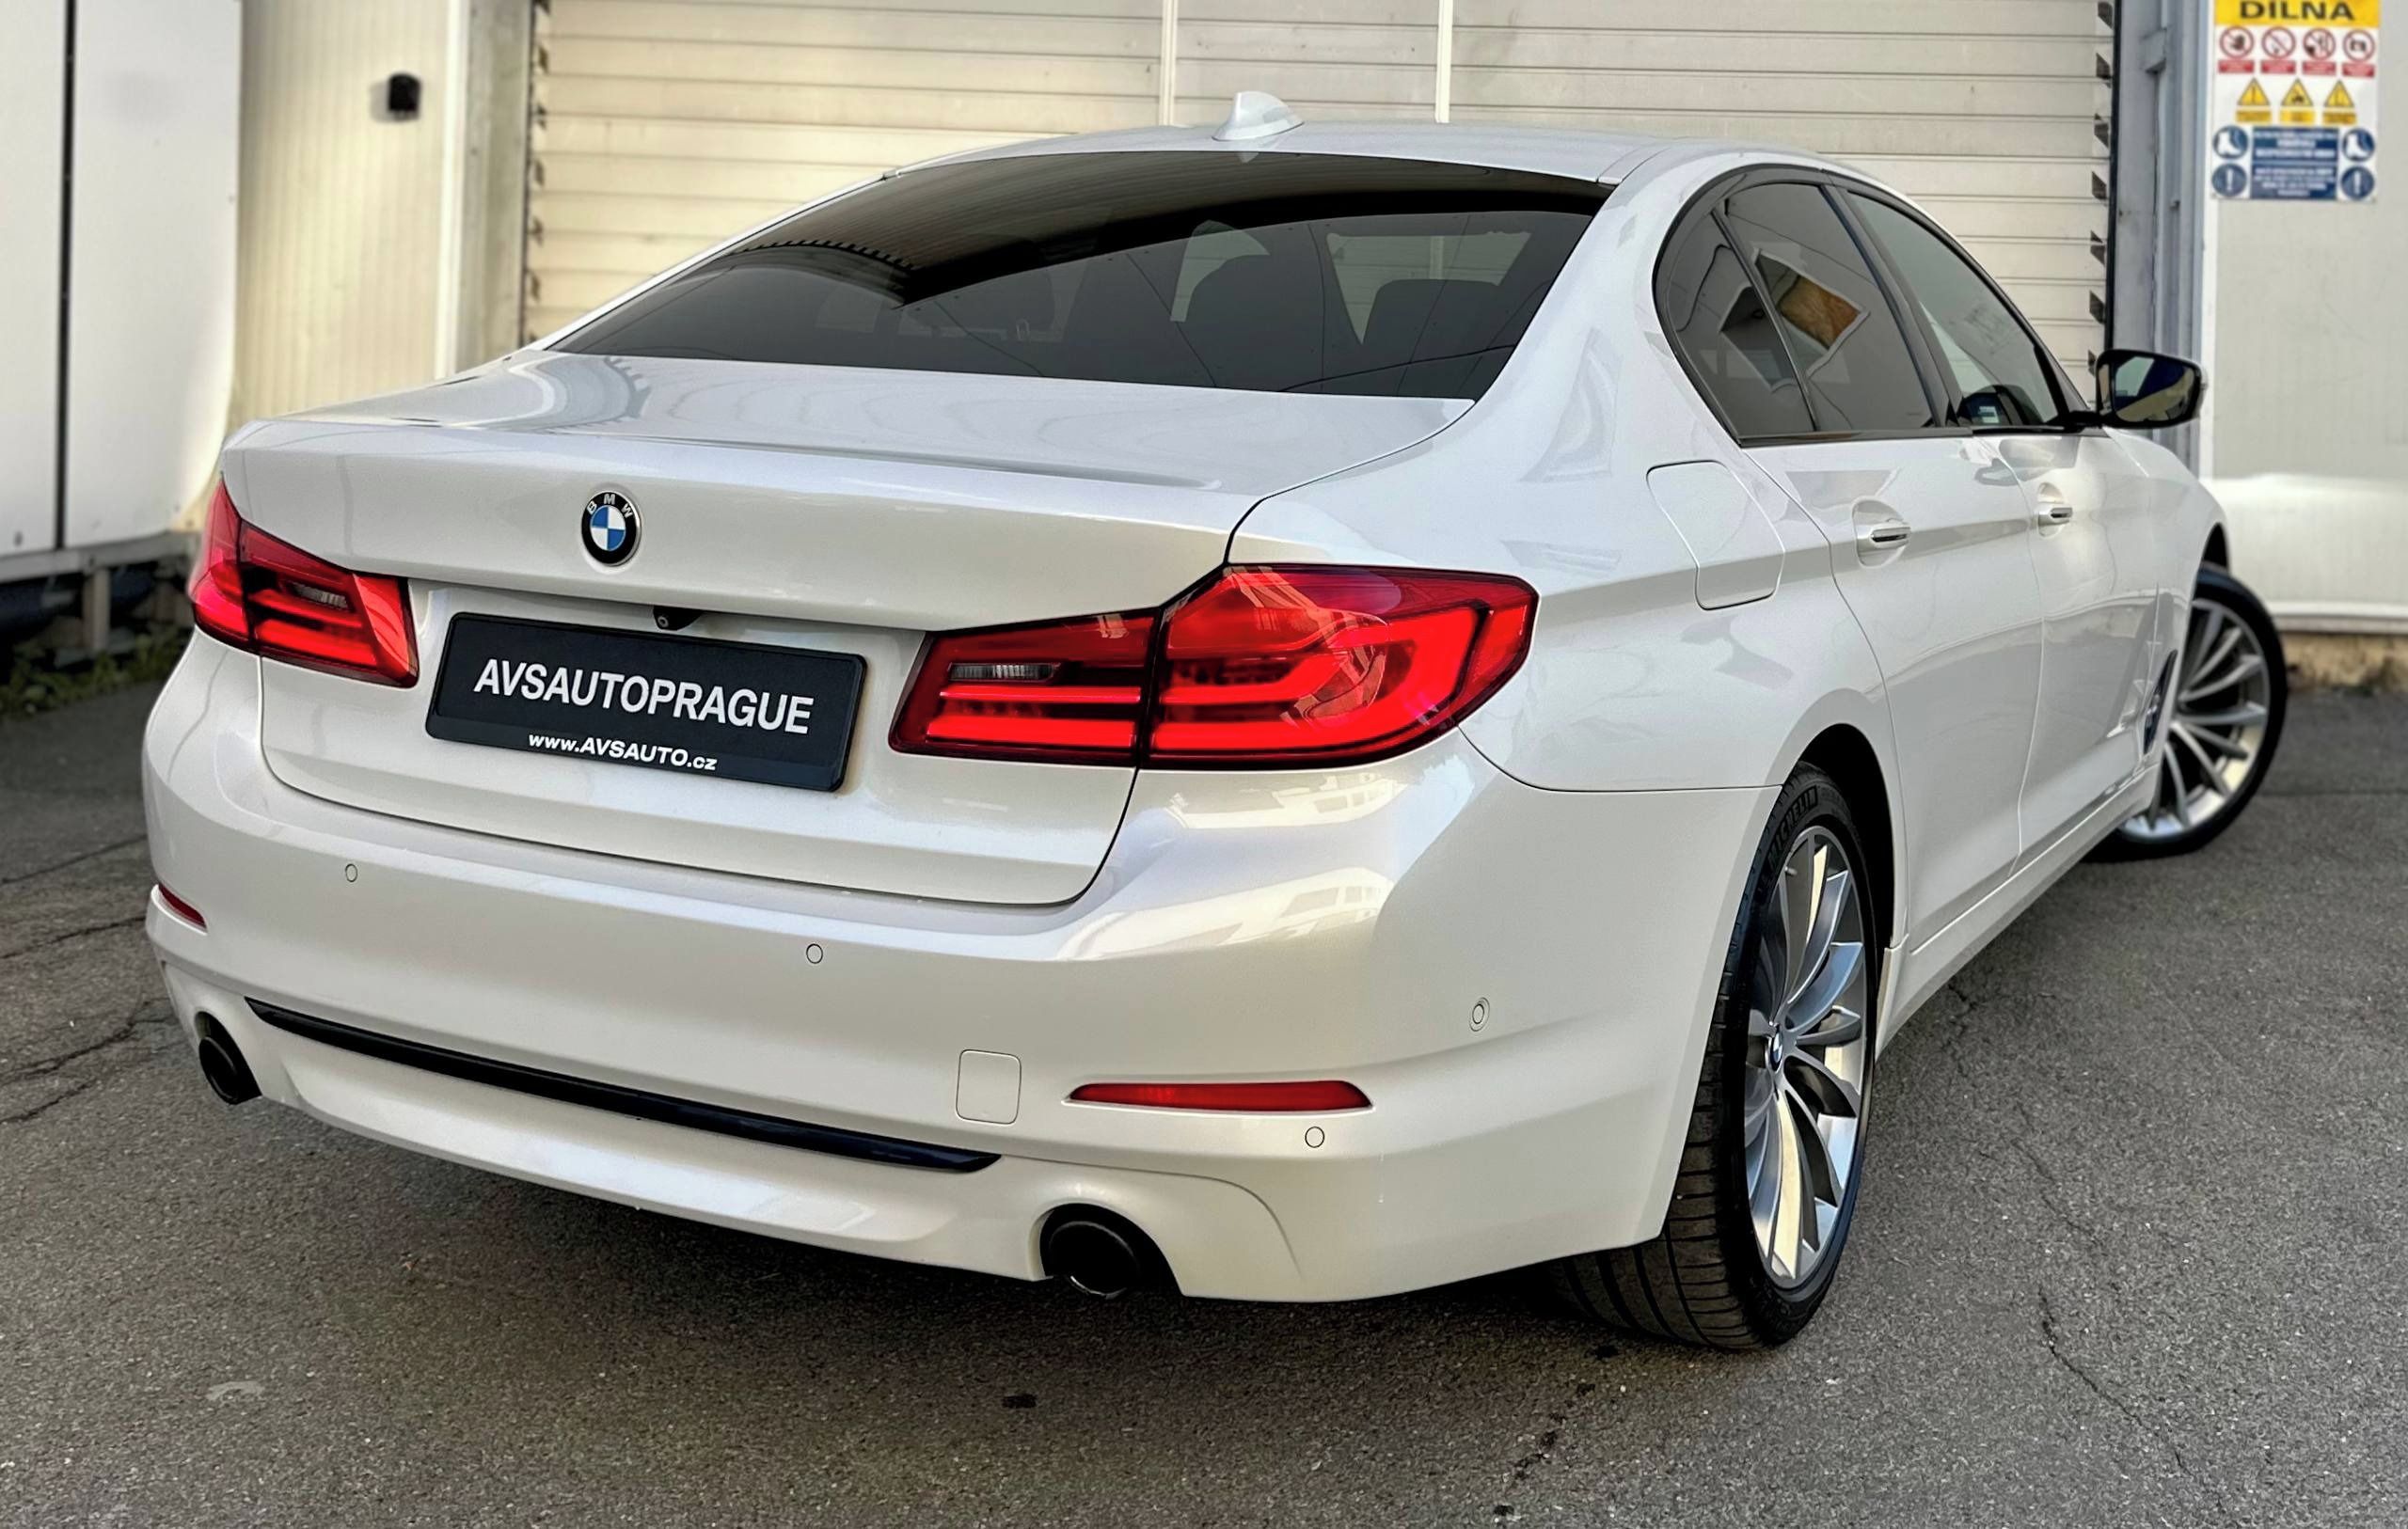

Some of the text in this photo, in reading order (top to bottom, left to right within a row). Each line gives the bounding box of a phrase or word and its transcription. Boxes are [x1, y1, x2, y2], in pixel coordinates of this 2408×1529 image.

[586, 493, 633, 518] BMW
[474, 659, 814, 733] AVSAUTOPRAGUE
[529, 734, 718, 770] www.AVSAUTO.cz
